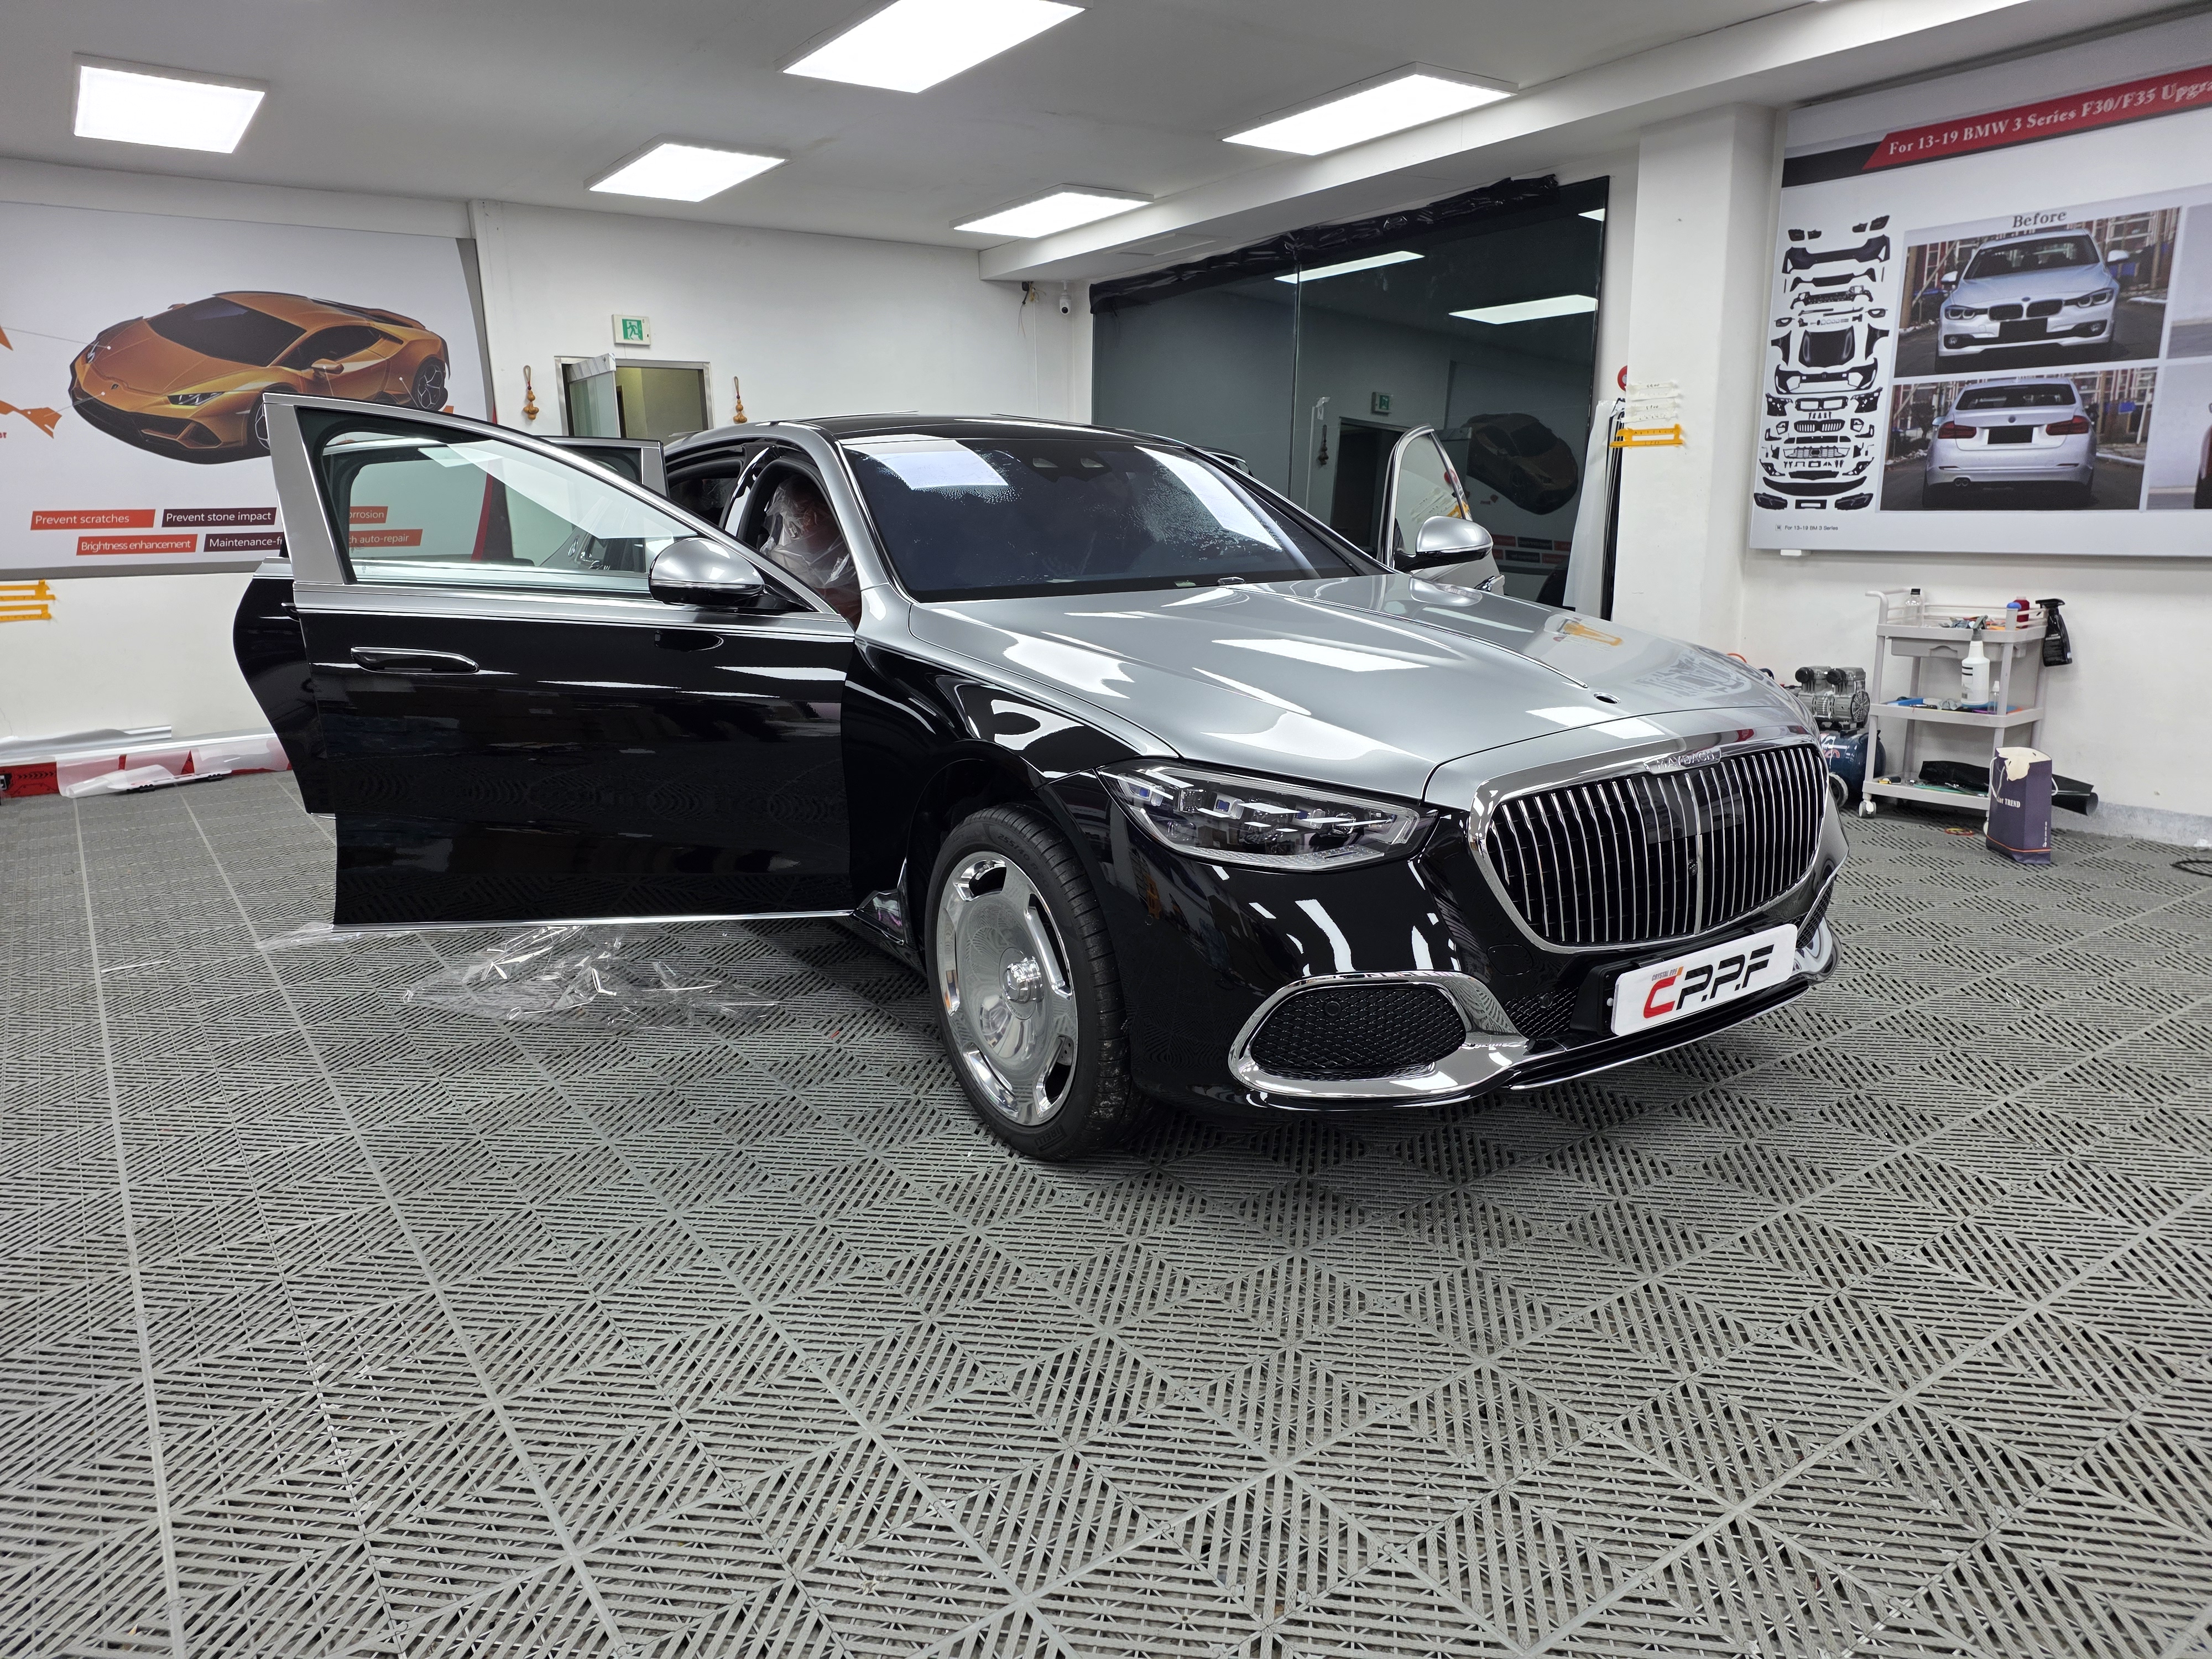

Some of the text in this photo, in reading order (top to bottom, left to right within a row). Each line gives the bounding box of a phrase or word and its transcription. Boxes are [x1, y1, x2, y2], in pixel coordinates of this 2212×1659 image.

[1888, 140, 1914, 155] For
[1917, 130, 1959, 149] 13-19
[1963, 118, 2010, 141] BMW
[2012, 117, 2022, 132] 3
[2026, 111, 2077, 128] Series
[2080, 88, 2157, 118] F30/F35
[2012, 211, 2068, 228] Before
[35, 514, 130, 524] Prevent scratches
[166, 512, 272, 523] Prevent stone impact
[359, 533, 409, 544] auto-repair
[81, 540, 191, 553] Brightness enhancement
[1656, 749, 1715, 770] MAYBACH
[2005, 798, 2021, 808] TREND
[997, 833, 1030, 862] 255/40
[1651, 968, 1678, 982] CRYSTAL PPF
[1034, 1124, 1068, 1152] PIRELLI
